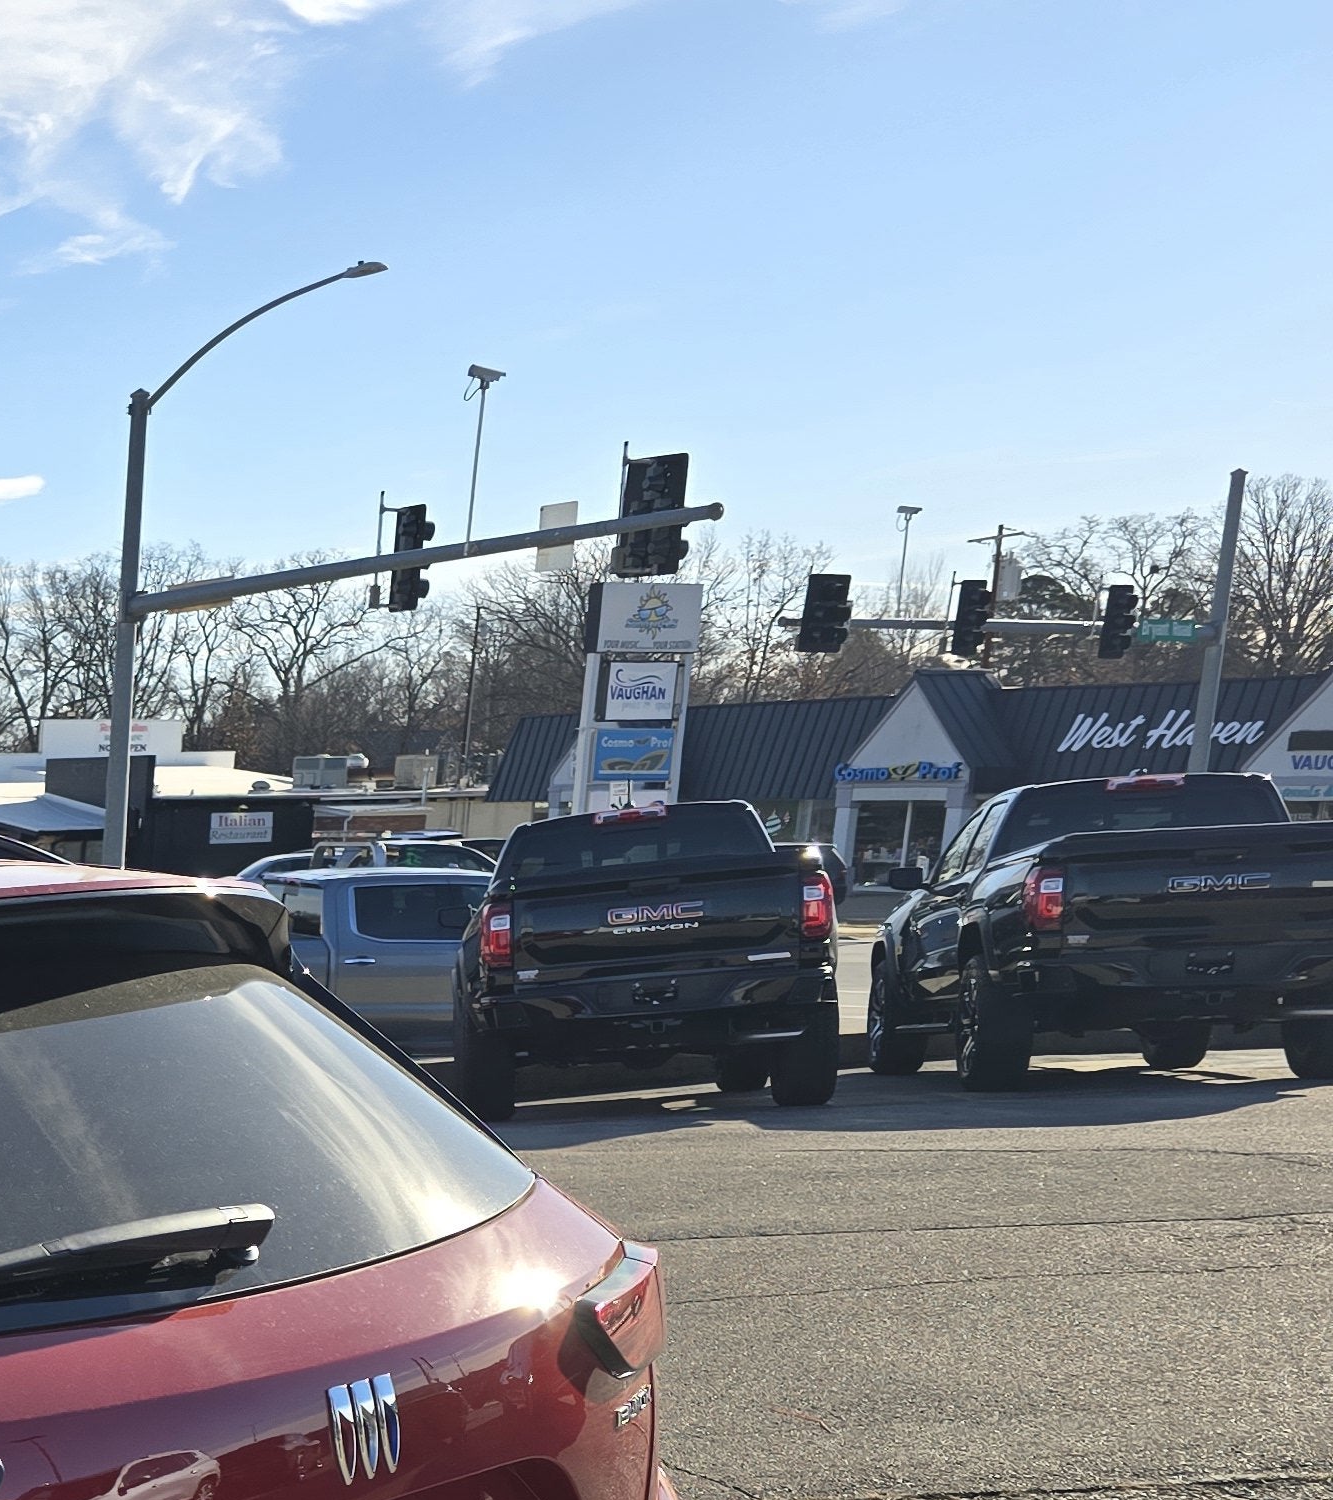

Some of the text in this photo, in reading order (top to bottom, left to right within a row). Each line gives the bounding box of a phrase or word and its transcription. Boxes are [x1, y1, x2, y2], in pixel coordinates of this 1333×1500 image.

[610, 686, 667, 700] VAUGHAN
[1057, 712, 1146, 753] West
[601, 736, 634, 748] Cosmo
[834, 761, 964, 781] Cosmo Prof
[218, 815, 266, 828] Italian
[211, 829, 269, 841] Restaurant
[1167, 872, 1271, 893] GMC
[608, 901, 703, 925] GMC
[613, 922, 699, 935] CANYON
